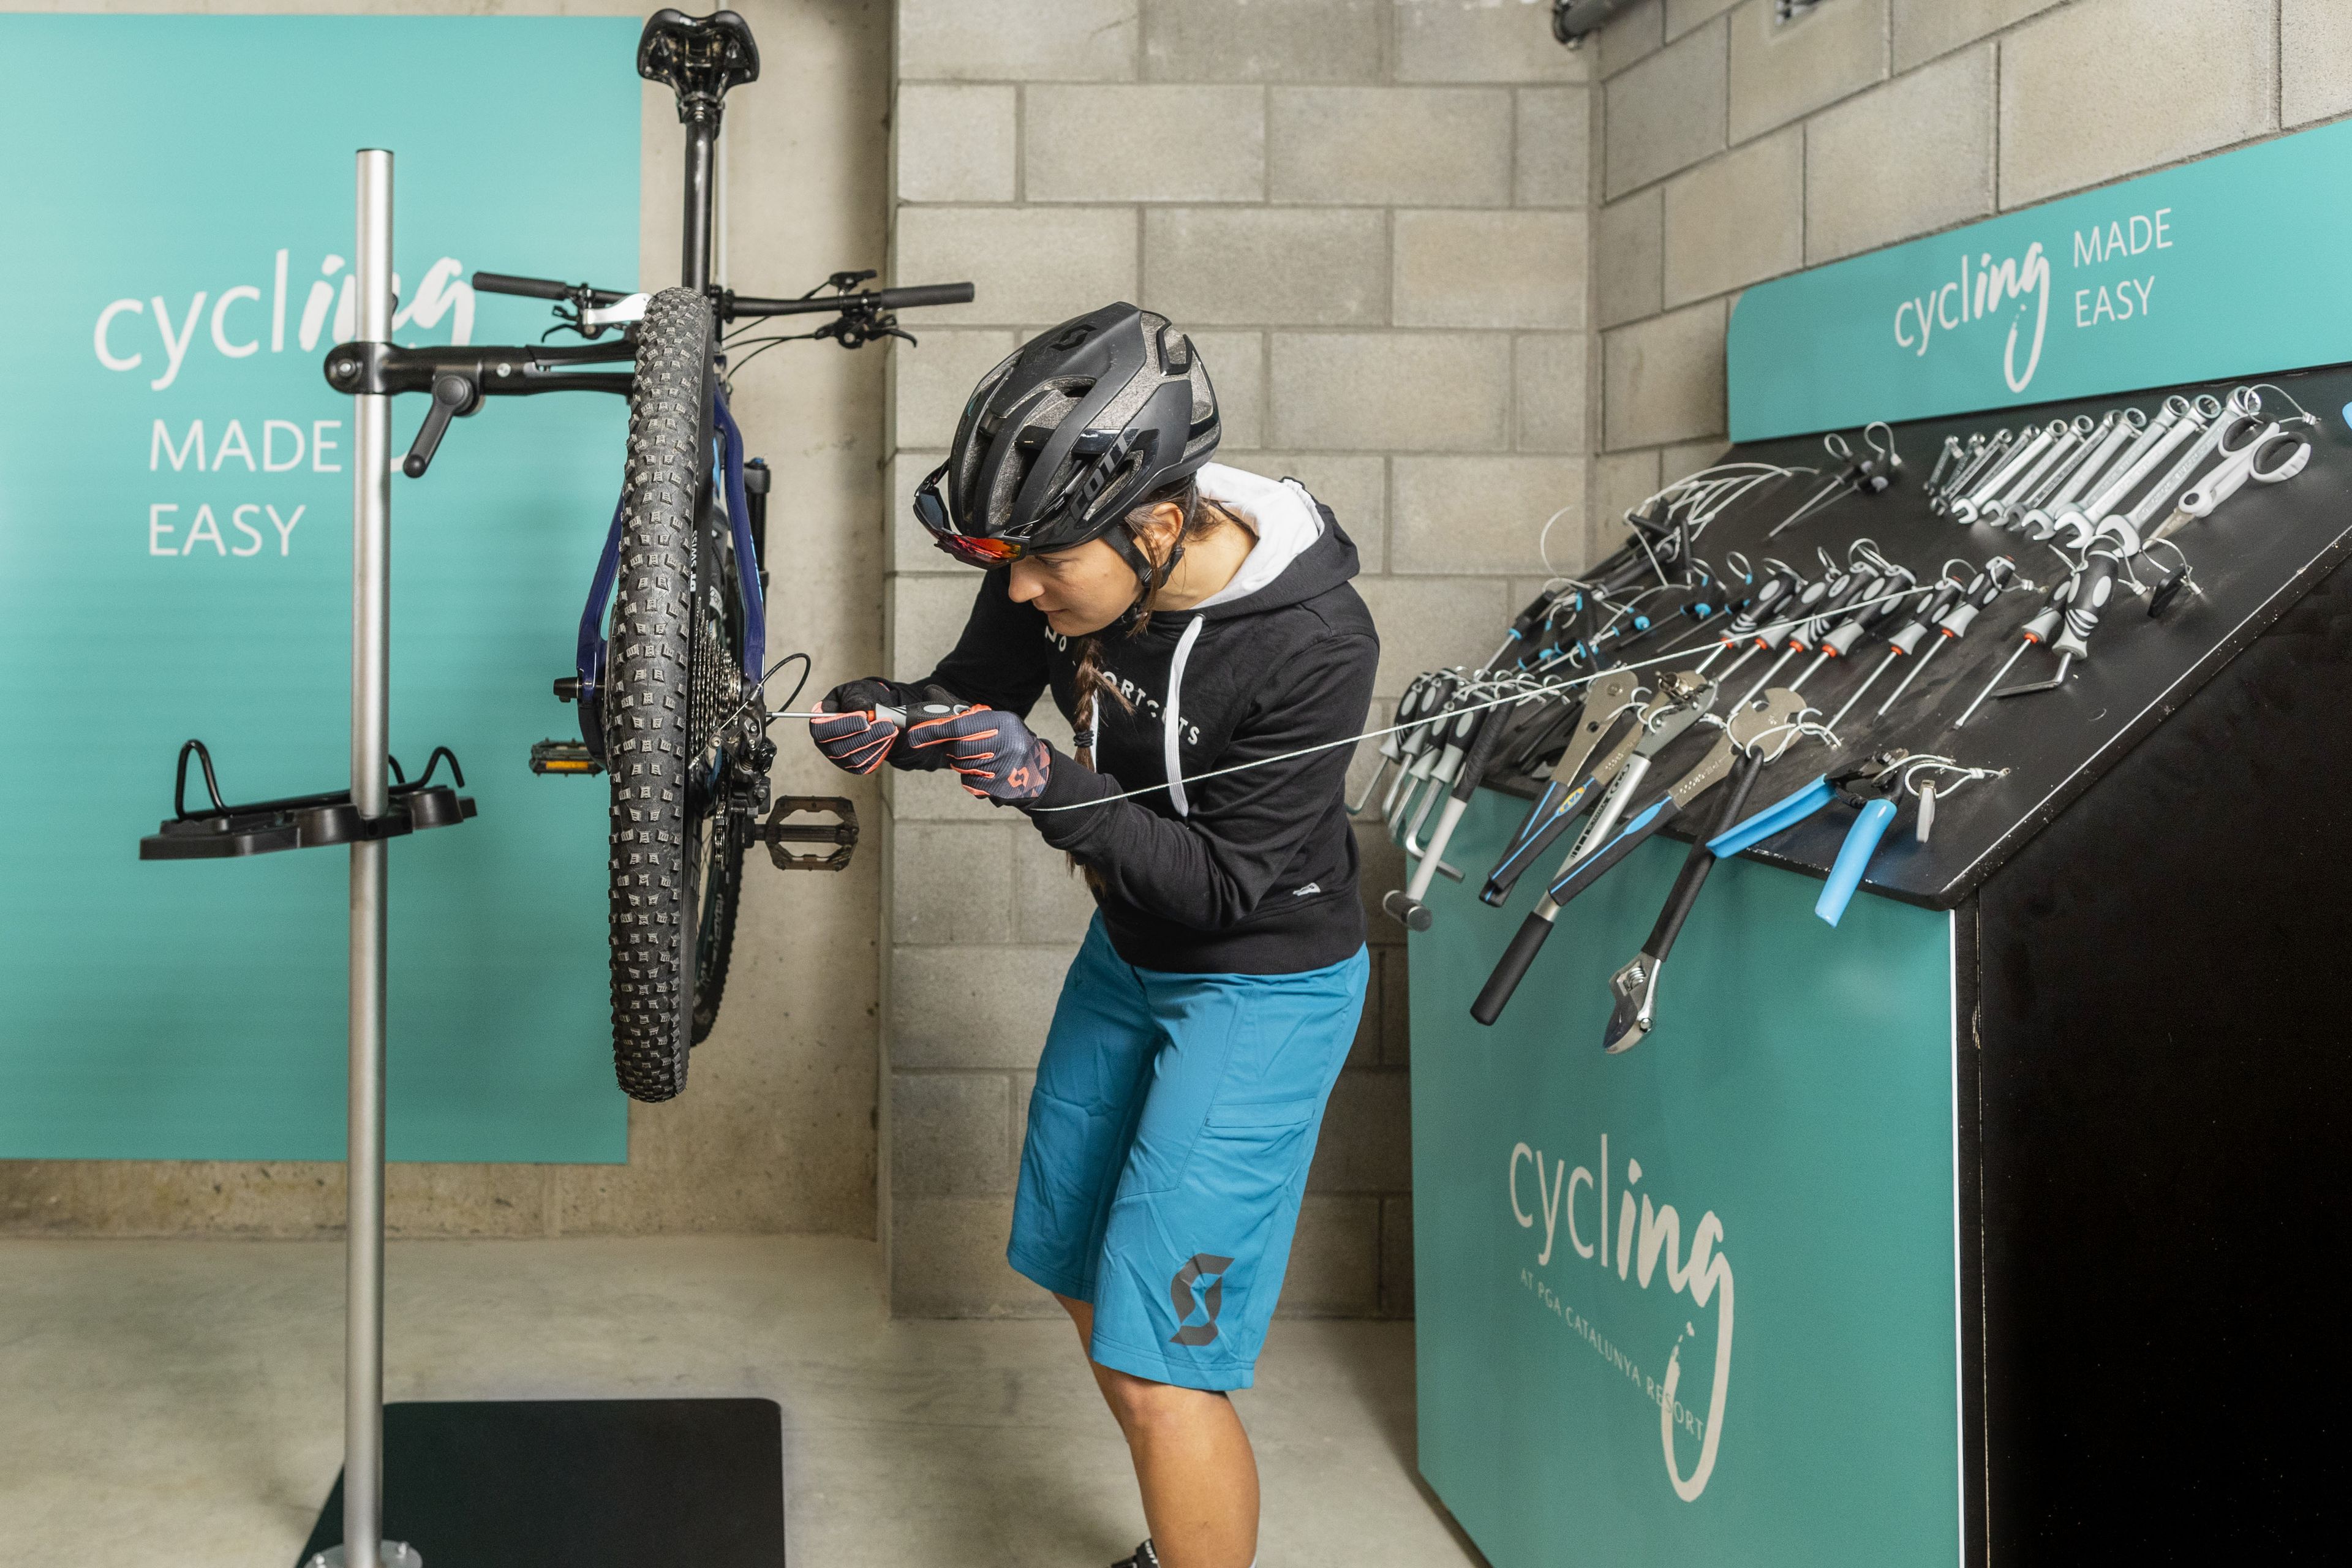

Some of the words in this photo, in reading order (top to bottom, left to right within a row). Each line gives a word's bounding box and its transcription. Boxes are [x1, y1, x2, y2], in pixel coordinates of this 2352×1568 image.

[2074, 208, 2173, 268] MADE
[1894, 242, 2050, 393] cycling
[2075, 276, 2155, 328] EASY
[149, 420, 342, 472] MADE
[1054, 434, 1129, 535] SCOTT
[149, 503, 306, 556] EASY
[1510, 1133, 1734, 1502] cycling
[1538, 1281, 1561, 1317] PGA
[1566, 1306, 1641, 1387] CATALUNYA
[1646, 1376, 1703, 1441] RESORT
